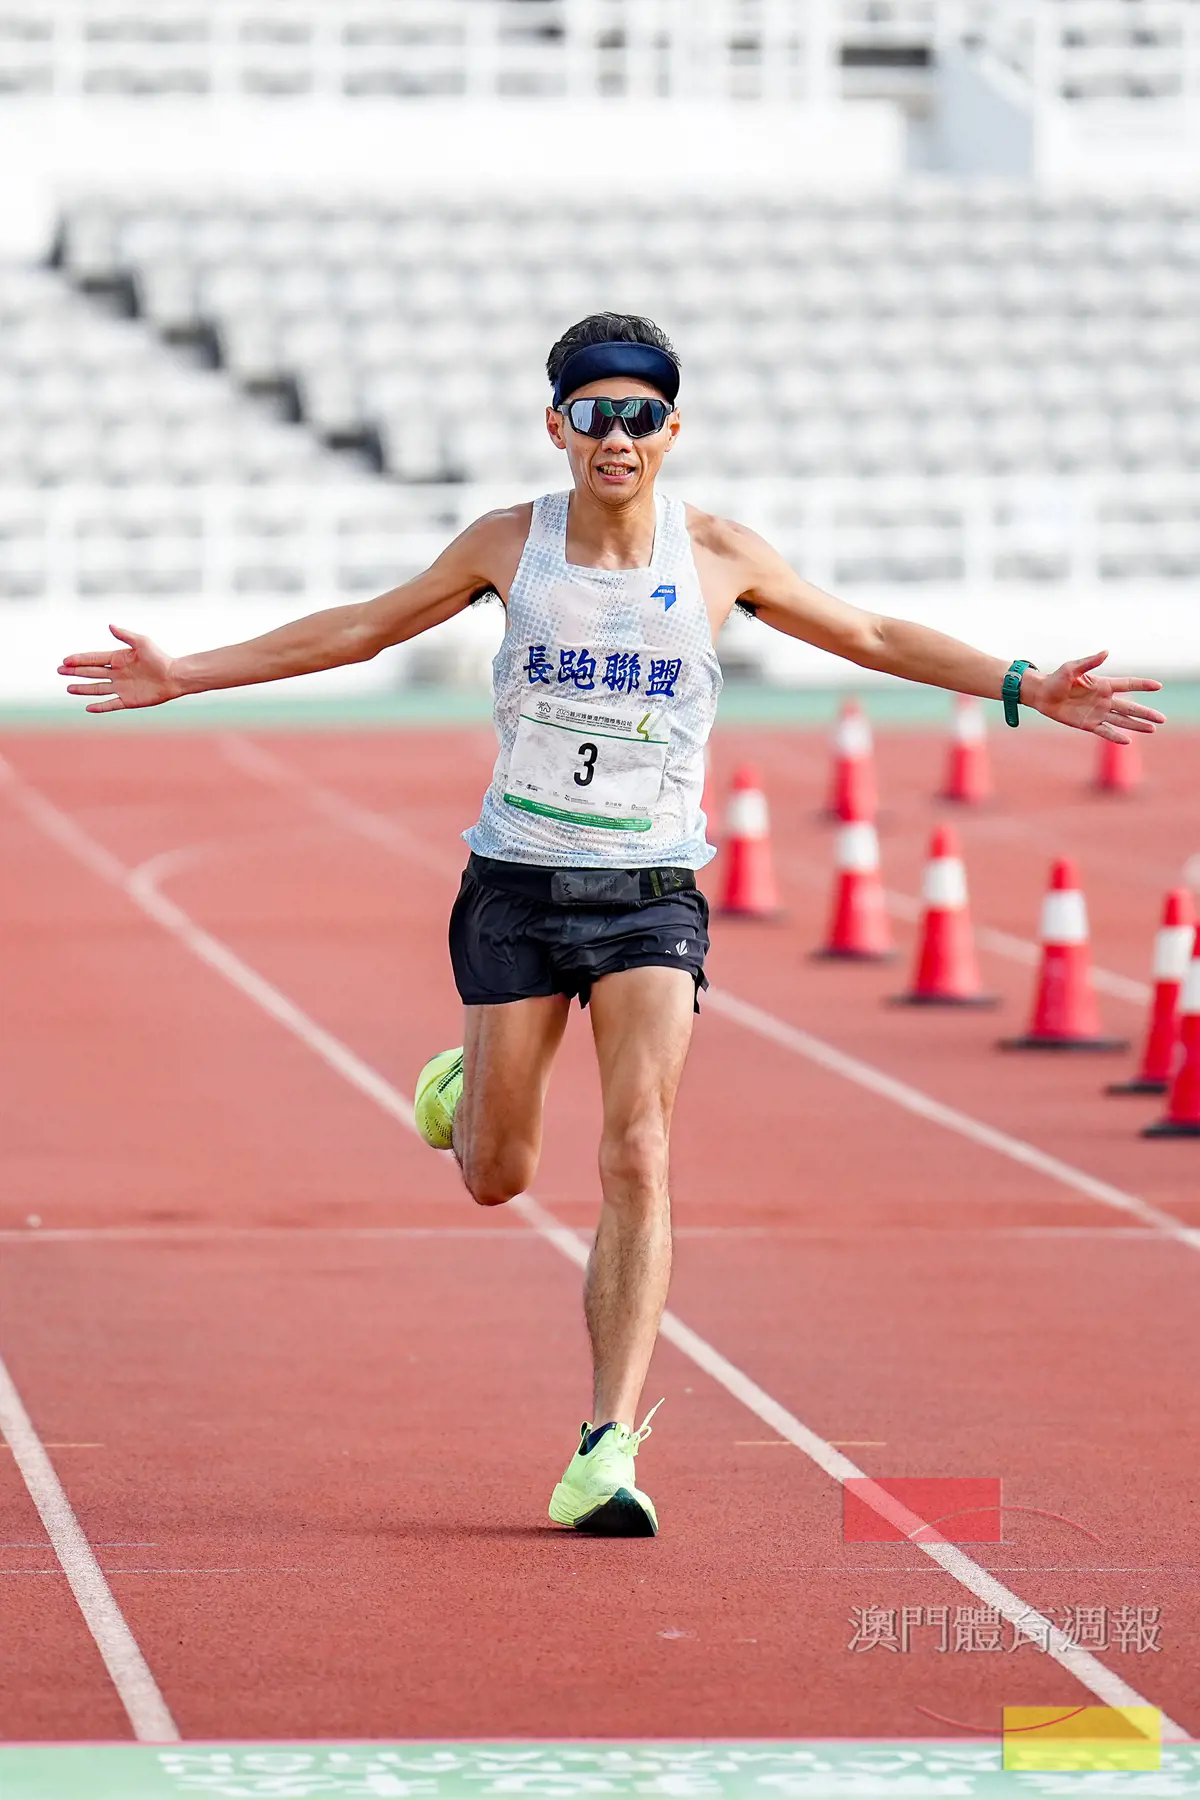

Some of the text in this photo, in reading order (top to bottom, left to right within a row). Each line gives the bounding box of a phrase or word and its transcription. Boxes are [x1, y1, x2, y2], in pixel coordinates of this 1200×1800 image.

[523, 645, 683, 698] 長跑聯盟
[573, 742, 598, 787] 3
